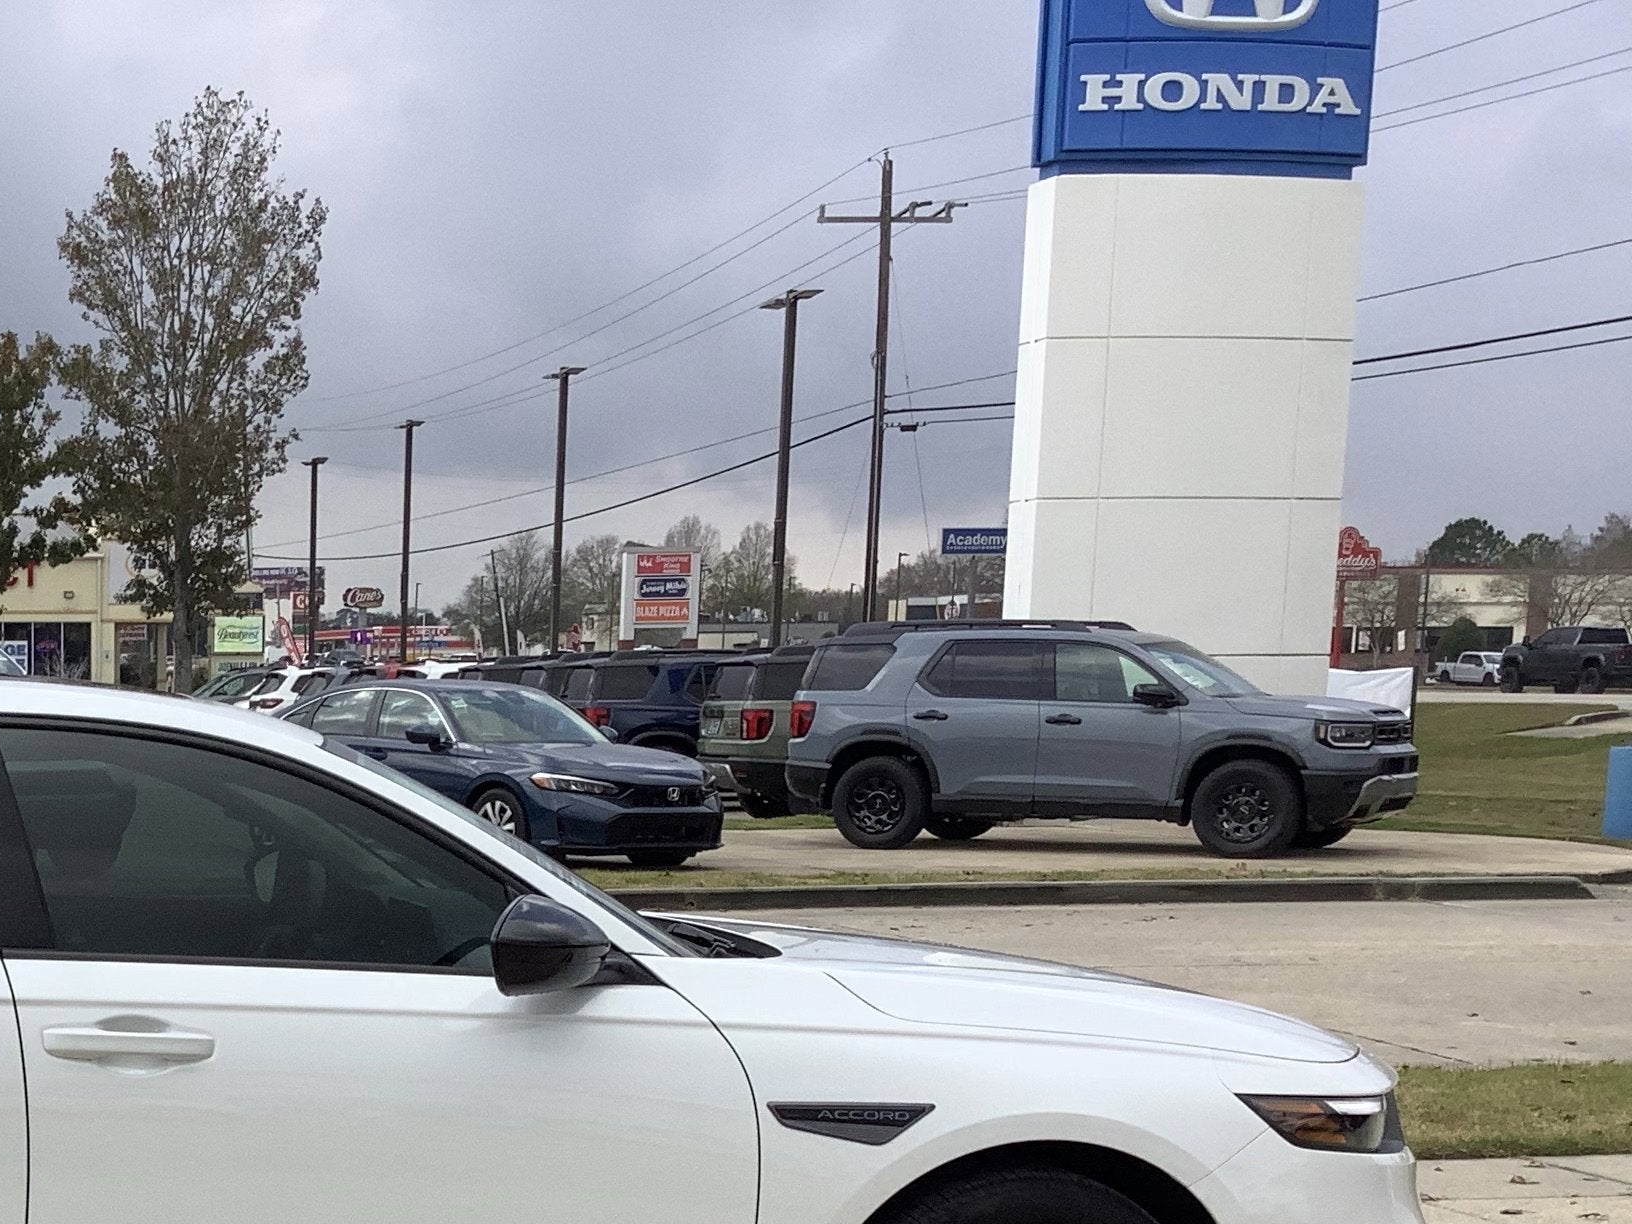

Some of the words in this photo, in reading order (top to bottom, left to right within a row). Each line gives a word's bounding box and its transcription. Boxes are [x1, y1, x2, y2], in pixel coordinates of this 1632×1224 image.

[1077, 72, 1361, 115] HONDA
[946, 533, 1007, 549] Academy
[1337, 553, 1376, 570] eddy's
[817, 1110, 910, 1120] ACCORD
